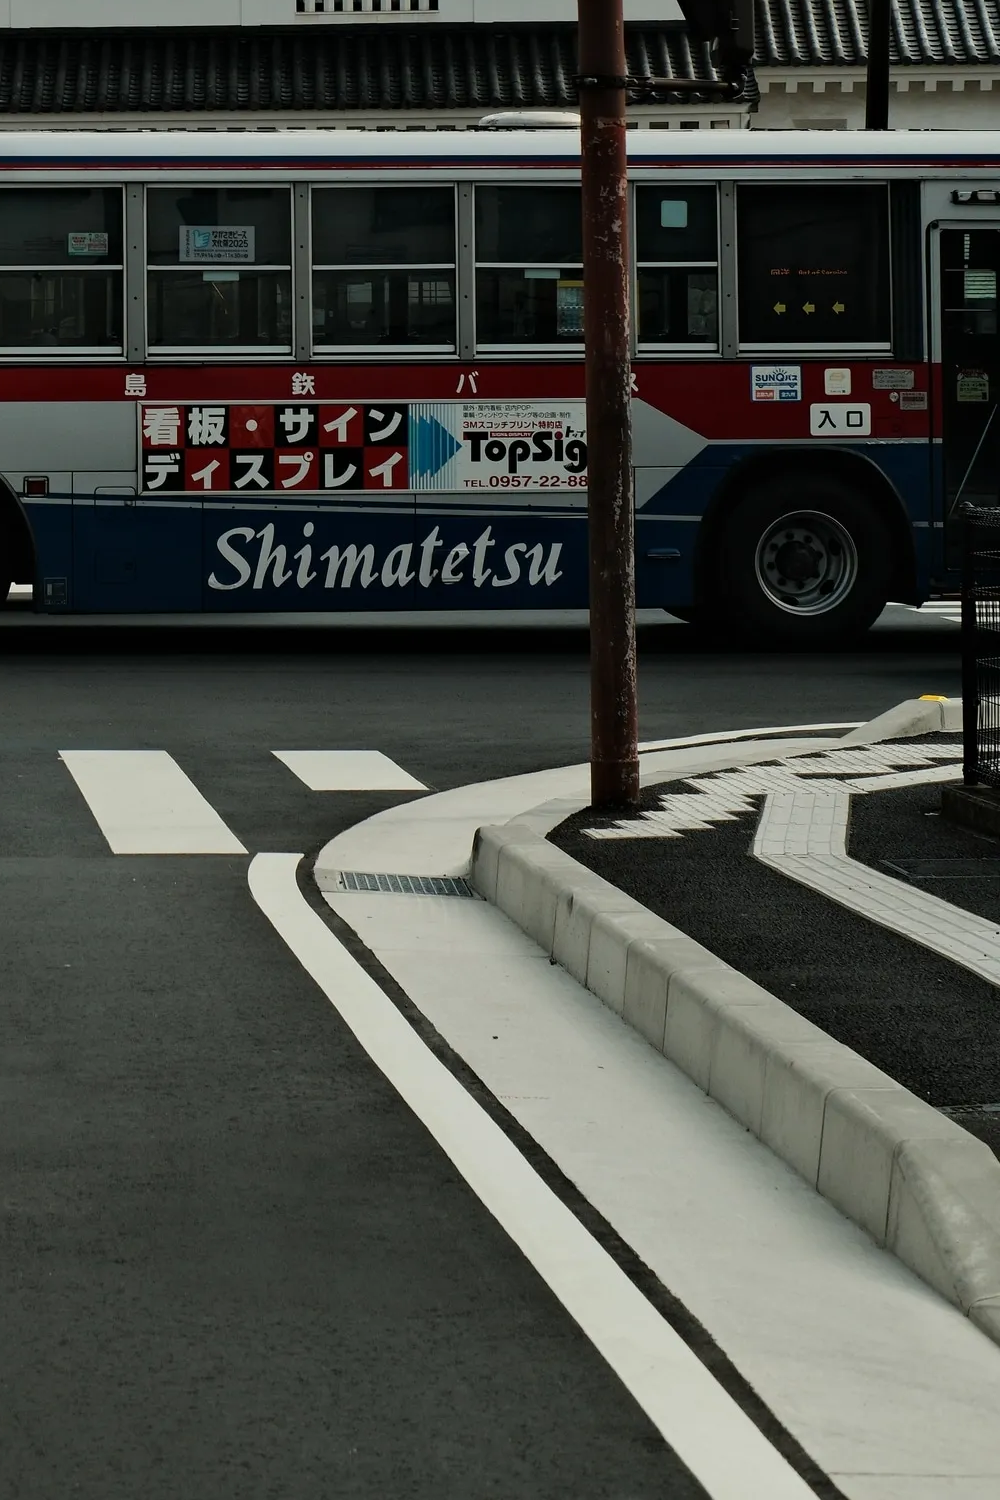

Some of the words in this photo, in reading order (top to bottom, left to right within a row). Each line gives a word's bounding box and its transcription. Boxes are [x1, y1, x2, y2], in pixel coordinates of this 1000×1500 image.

[143, 407, 402, 446] 看板・サイン
[462, 420, 563, 429] 3Mスコッチプリント特約店
[817, 410, 864, 429] 入口
[144, 451, 404, 490] ディスプレイ
[207, 520, 564, 590] Shimatetsu
